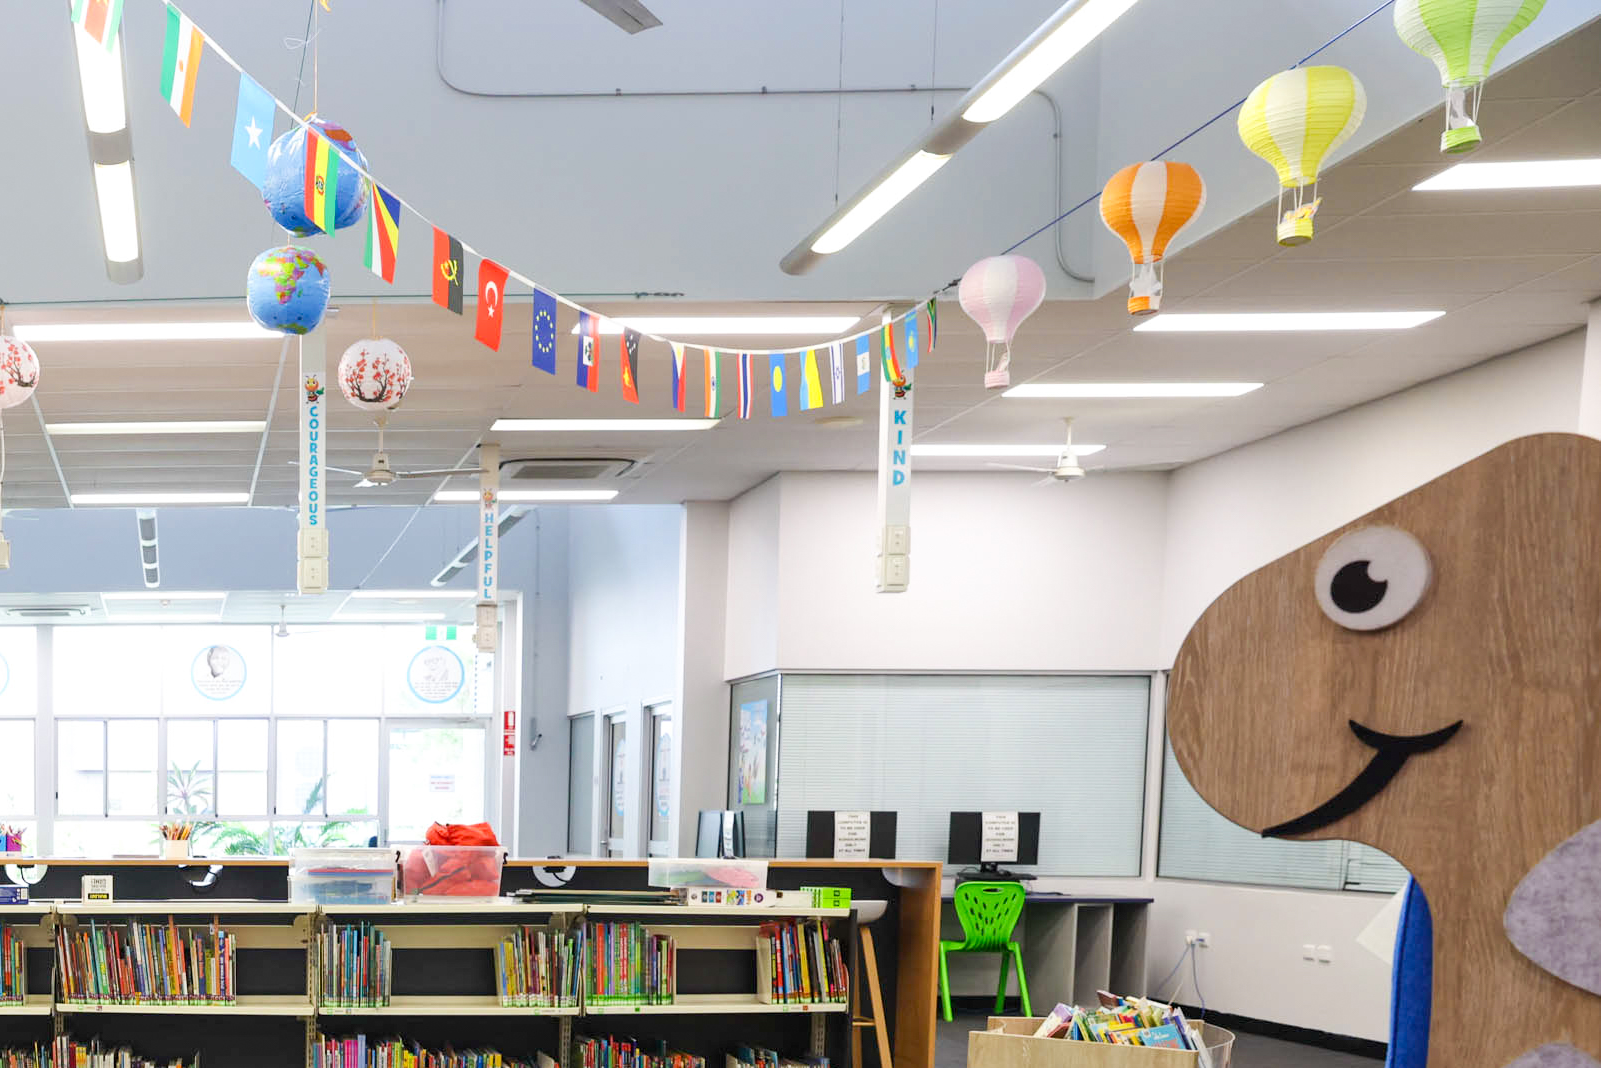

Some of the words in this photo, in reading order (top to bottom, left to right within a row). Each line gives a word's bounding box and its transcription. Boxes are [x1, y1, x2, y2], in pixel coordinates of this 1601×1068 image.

[308, 405, 320, 526] COURAGEOUS
[892, 409, 907, 486] KIND
[484, 512, 494, 599] HELPFUL
